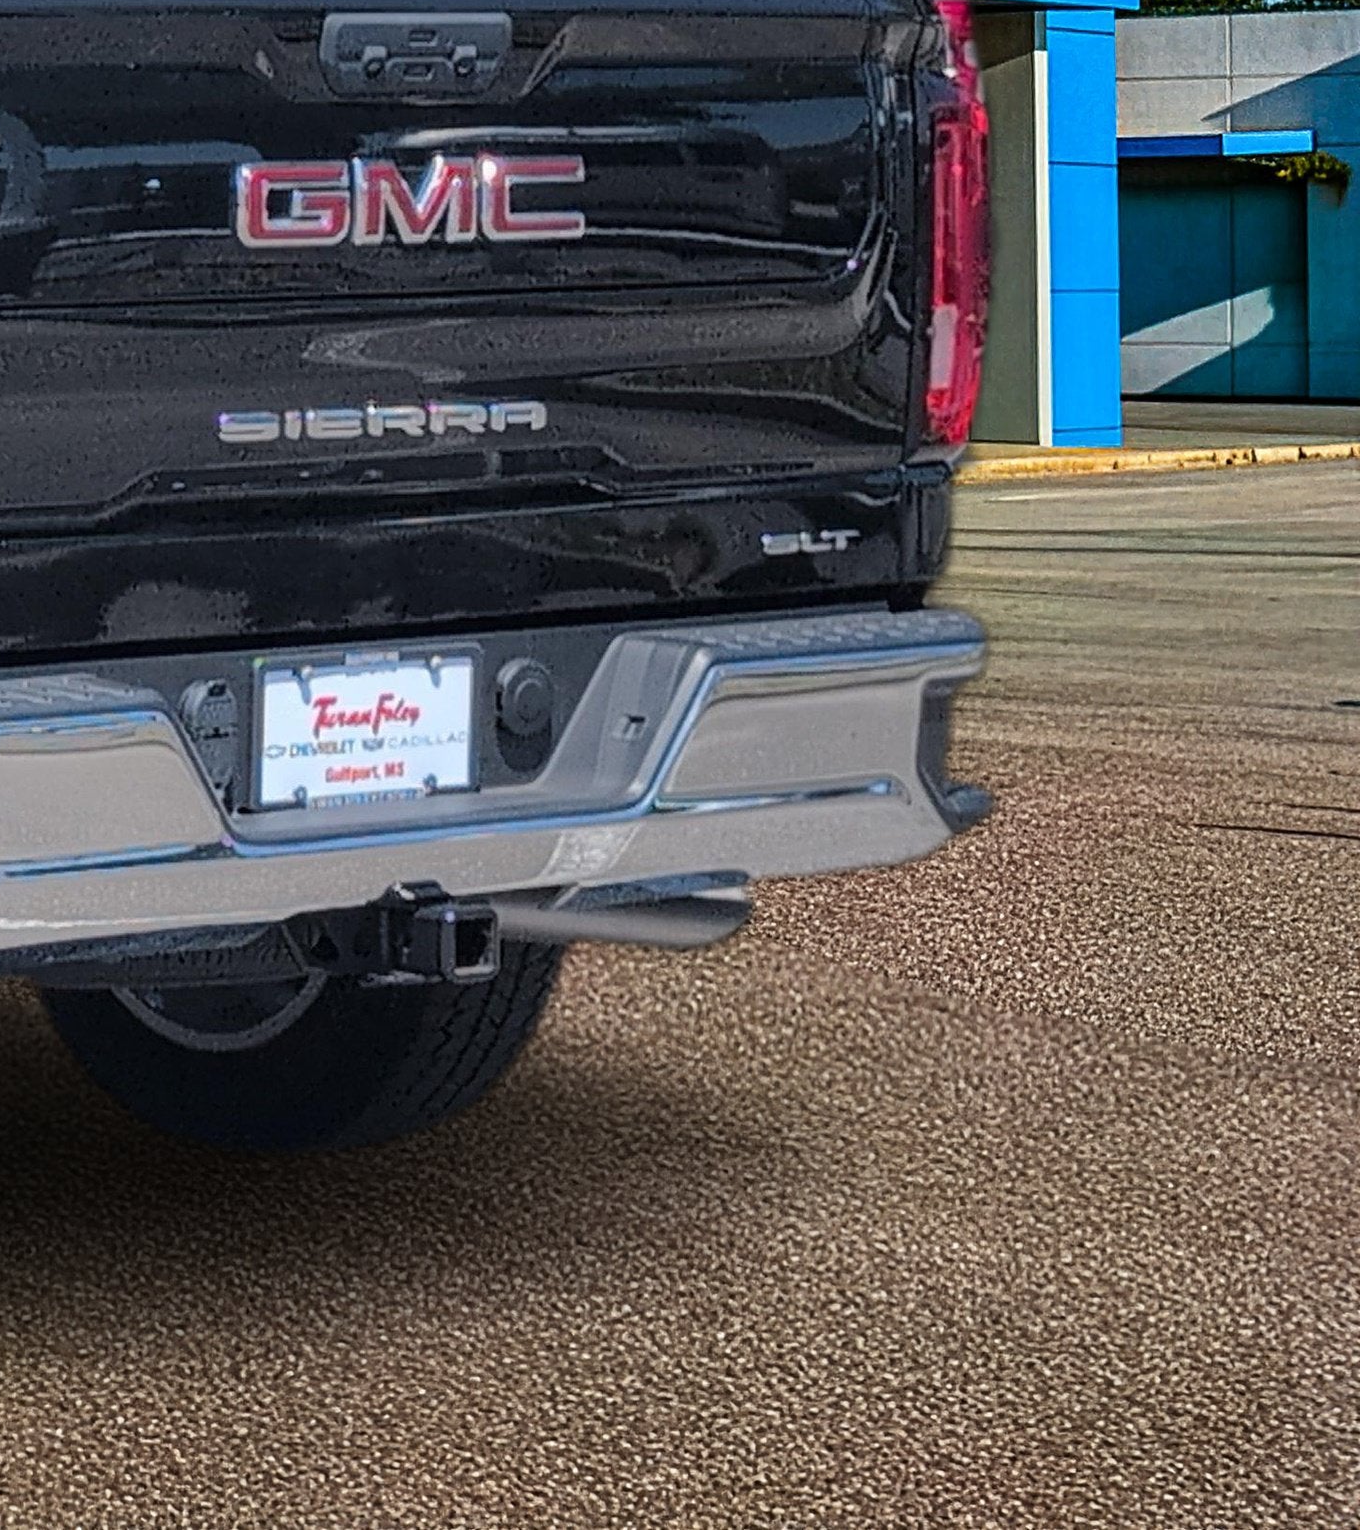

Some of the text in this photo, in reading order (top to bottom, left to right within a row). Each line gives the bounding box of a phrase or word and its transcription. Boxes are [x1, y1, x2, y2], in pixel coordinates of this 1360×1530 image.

[234, 154, 586, 248] GMC
[217, 400, 548, 443] SIERRA
[761, 528, 861, 555] SLT
[388, 731, 466, 749] CADILLAC
[383, 761, 405, 778] MS
